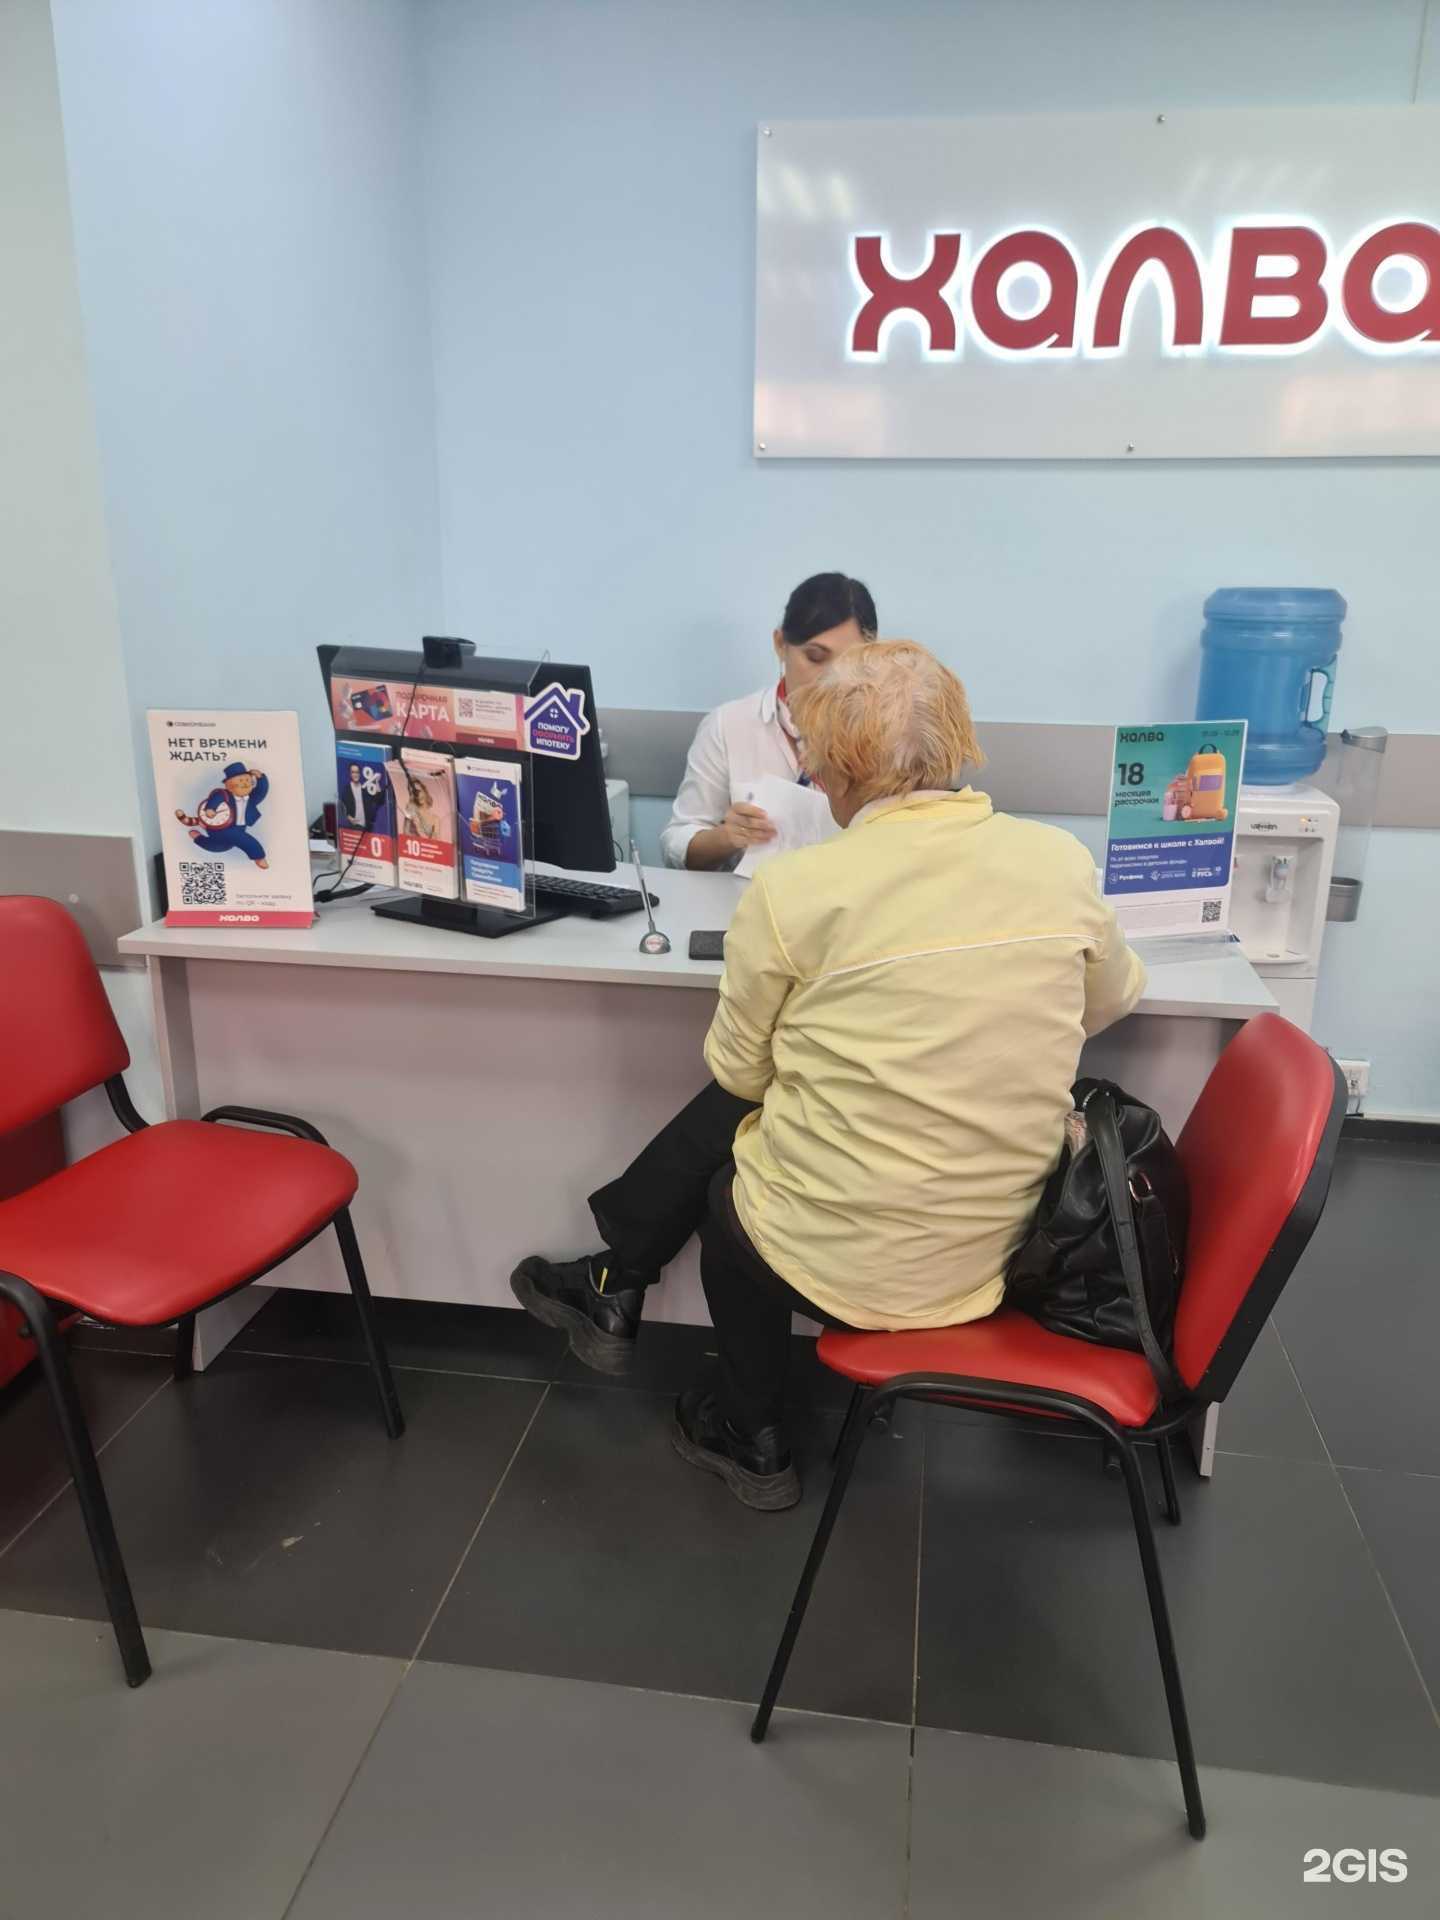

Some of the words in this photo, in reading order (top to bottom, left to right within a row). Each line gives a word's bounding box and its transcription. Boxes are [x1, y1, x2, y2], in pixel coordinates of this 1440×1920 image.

[396, 701, 450, 723] КАРТА
[537, 722, 571, 734] ПОМОГУ
[168, 738, 195, 748] НЕТ
[199, 738, 268, 750] ВРЕМЕНИ
[536, 738, 571, 750] ИПОТЕКУ
[169, 751, 228, 763] ЖДАТЬ?
[1118, 762, 1145, 786] 18
[406, 839, 420, 857] 10
[1160, 840, 1187, 849] школе
